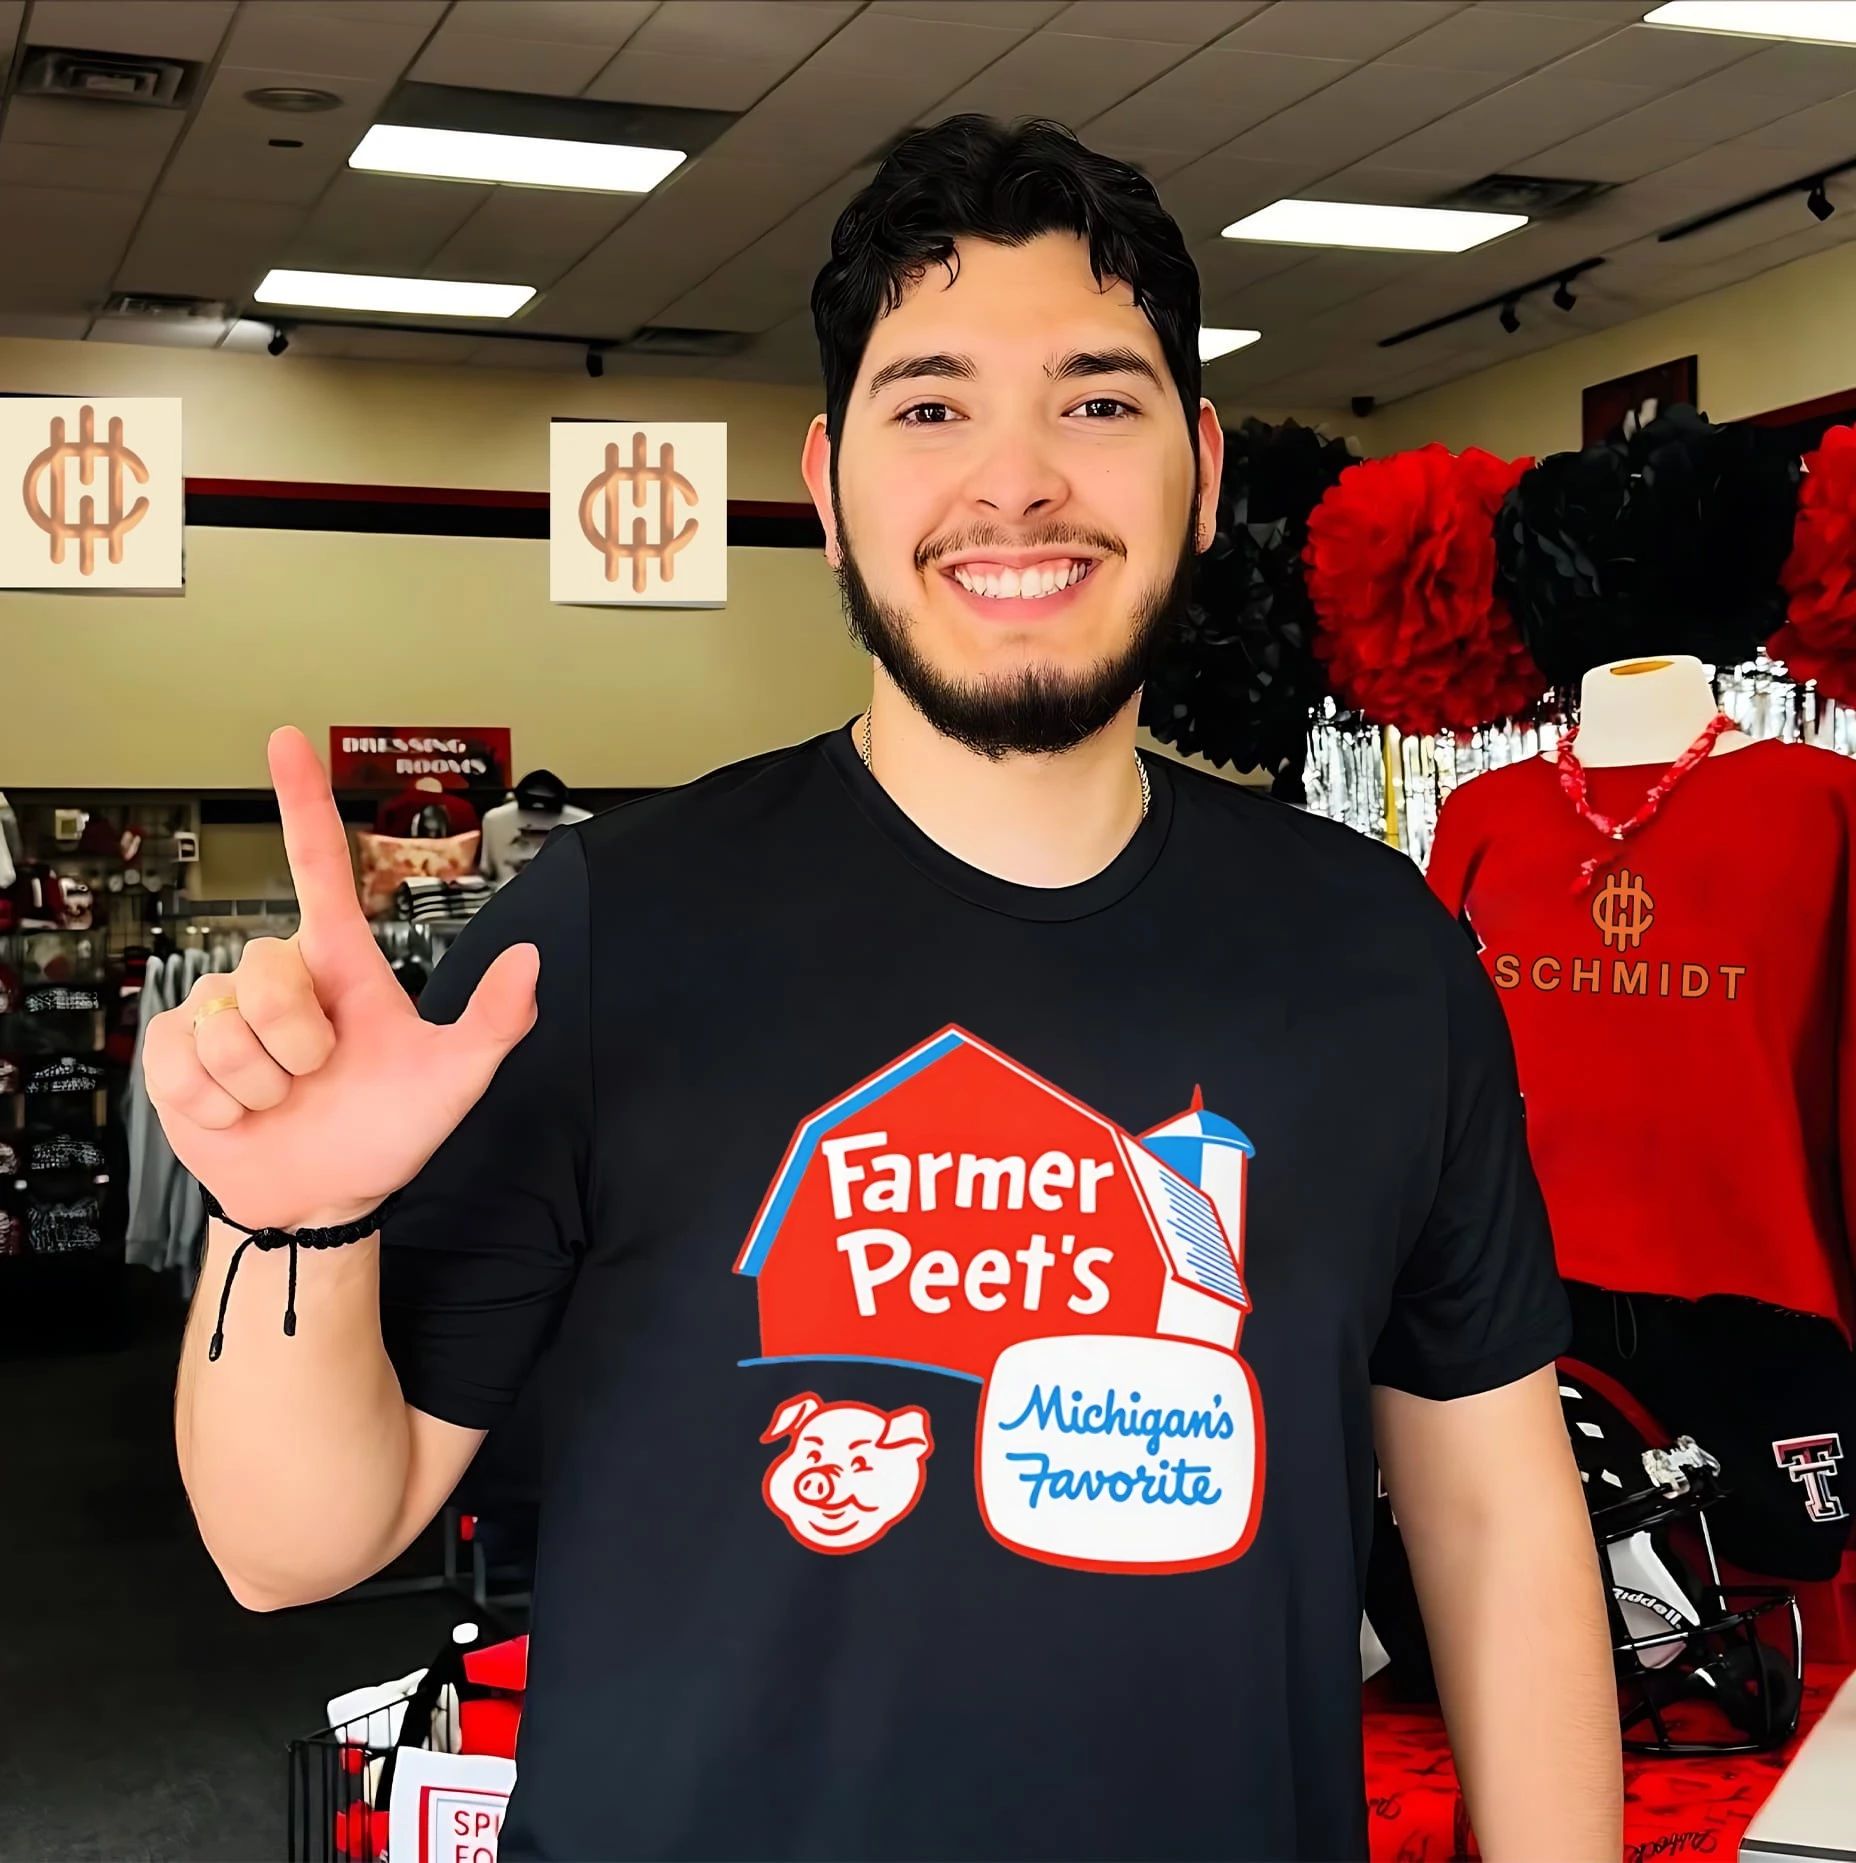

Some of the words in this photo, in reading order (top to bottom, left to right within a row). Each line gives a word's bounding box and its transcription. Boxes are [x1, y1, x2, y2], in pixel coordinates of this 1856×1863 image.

[396, 758, 487, 775] ROOMS
[1495, 953, 1747, 1000] SCHMIDT
[821, 1131, 1114, 1220] Farmer
[836, 1228, 1114, 1317] Peet's
[998, 1384, 1234, 1456] Michigan's
[1005, 1452, 1222, 1509] Favorite
